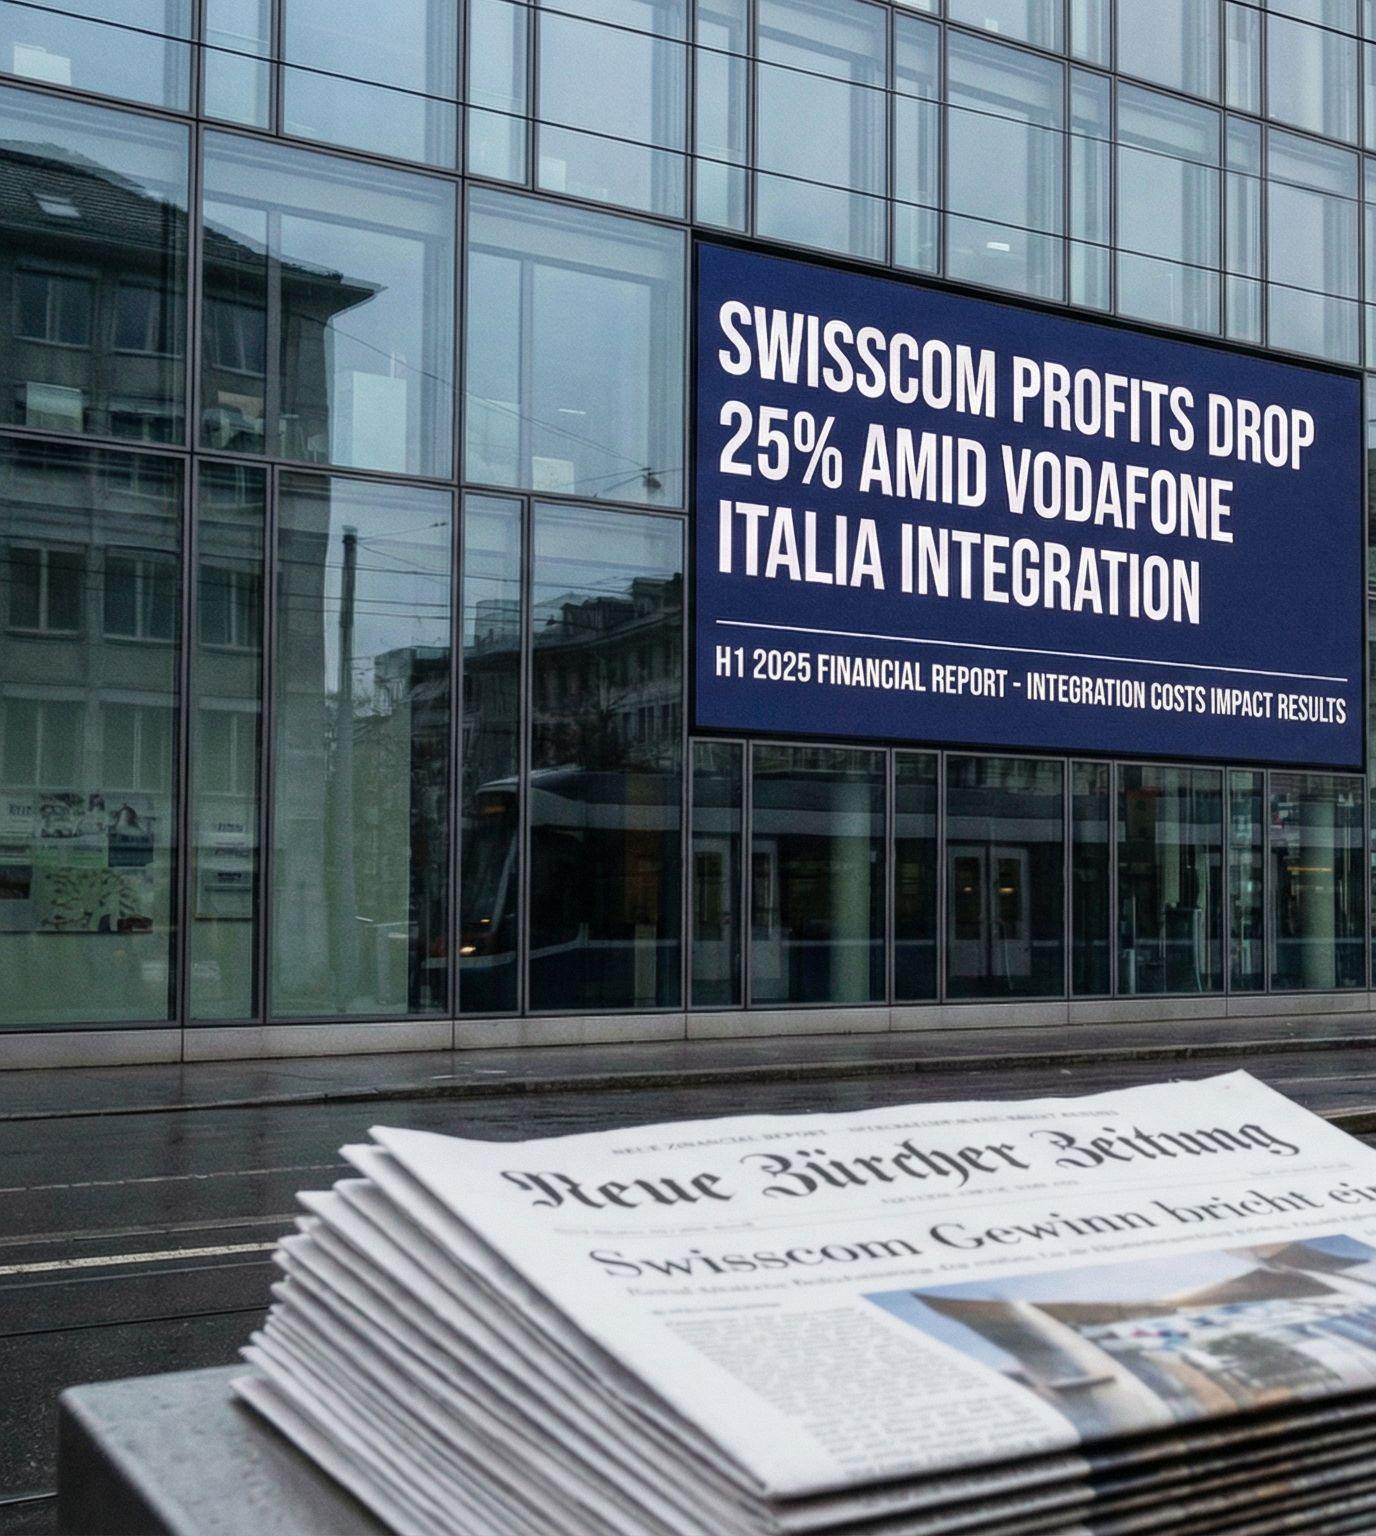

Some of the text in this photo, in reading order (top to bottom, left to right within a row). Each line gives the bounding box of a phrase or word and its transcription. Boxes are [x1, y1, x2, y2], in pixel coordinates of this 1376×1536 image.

[718, 300, 1315, 470] SWISSCOM PROFITS DROP
[719, 400, 1234, 544] 25% AMID VODAFONE
[718, 499, 1200, 625] ITALIA INTEGRATION
[715, 645, 744, 678] H1
[752, 648, 812, 683] 2025
[817, 653, 927, 692] FINANCIAL
[931, 663, 1009, 698] REPORT
[1027, 671, 1146, 709] INTEGRATION
[1150, 682, 1206, 714] COSTS
[1210, 687, 1274, 719] IMPACT
[1277, 693, 1347, 724] RESULTS
[501, 1172, 735, 1208] Neue
[740, 1138, 1030, 1198] Zürcher
[1029, 1123, 1301, 1169] Zeitung
[589, 1238, 923, 1278] Swisscom
[929, 1211, 1161, 1250] Gewinn
[1152, 1189, 1324, 1223] bricht
